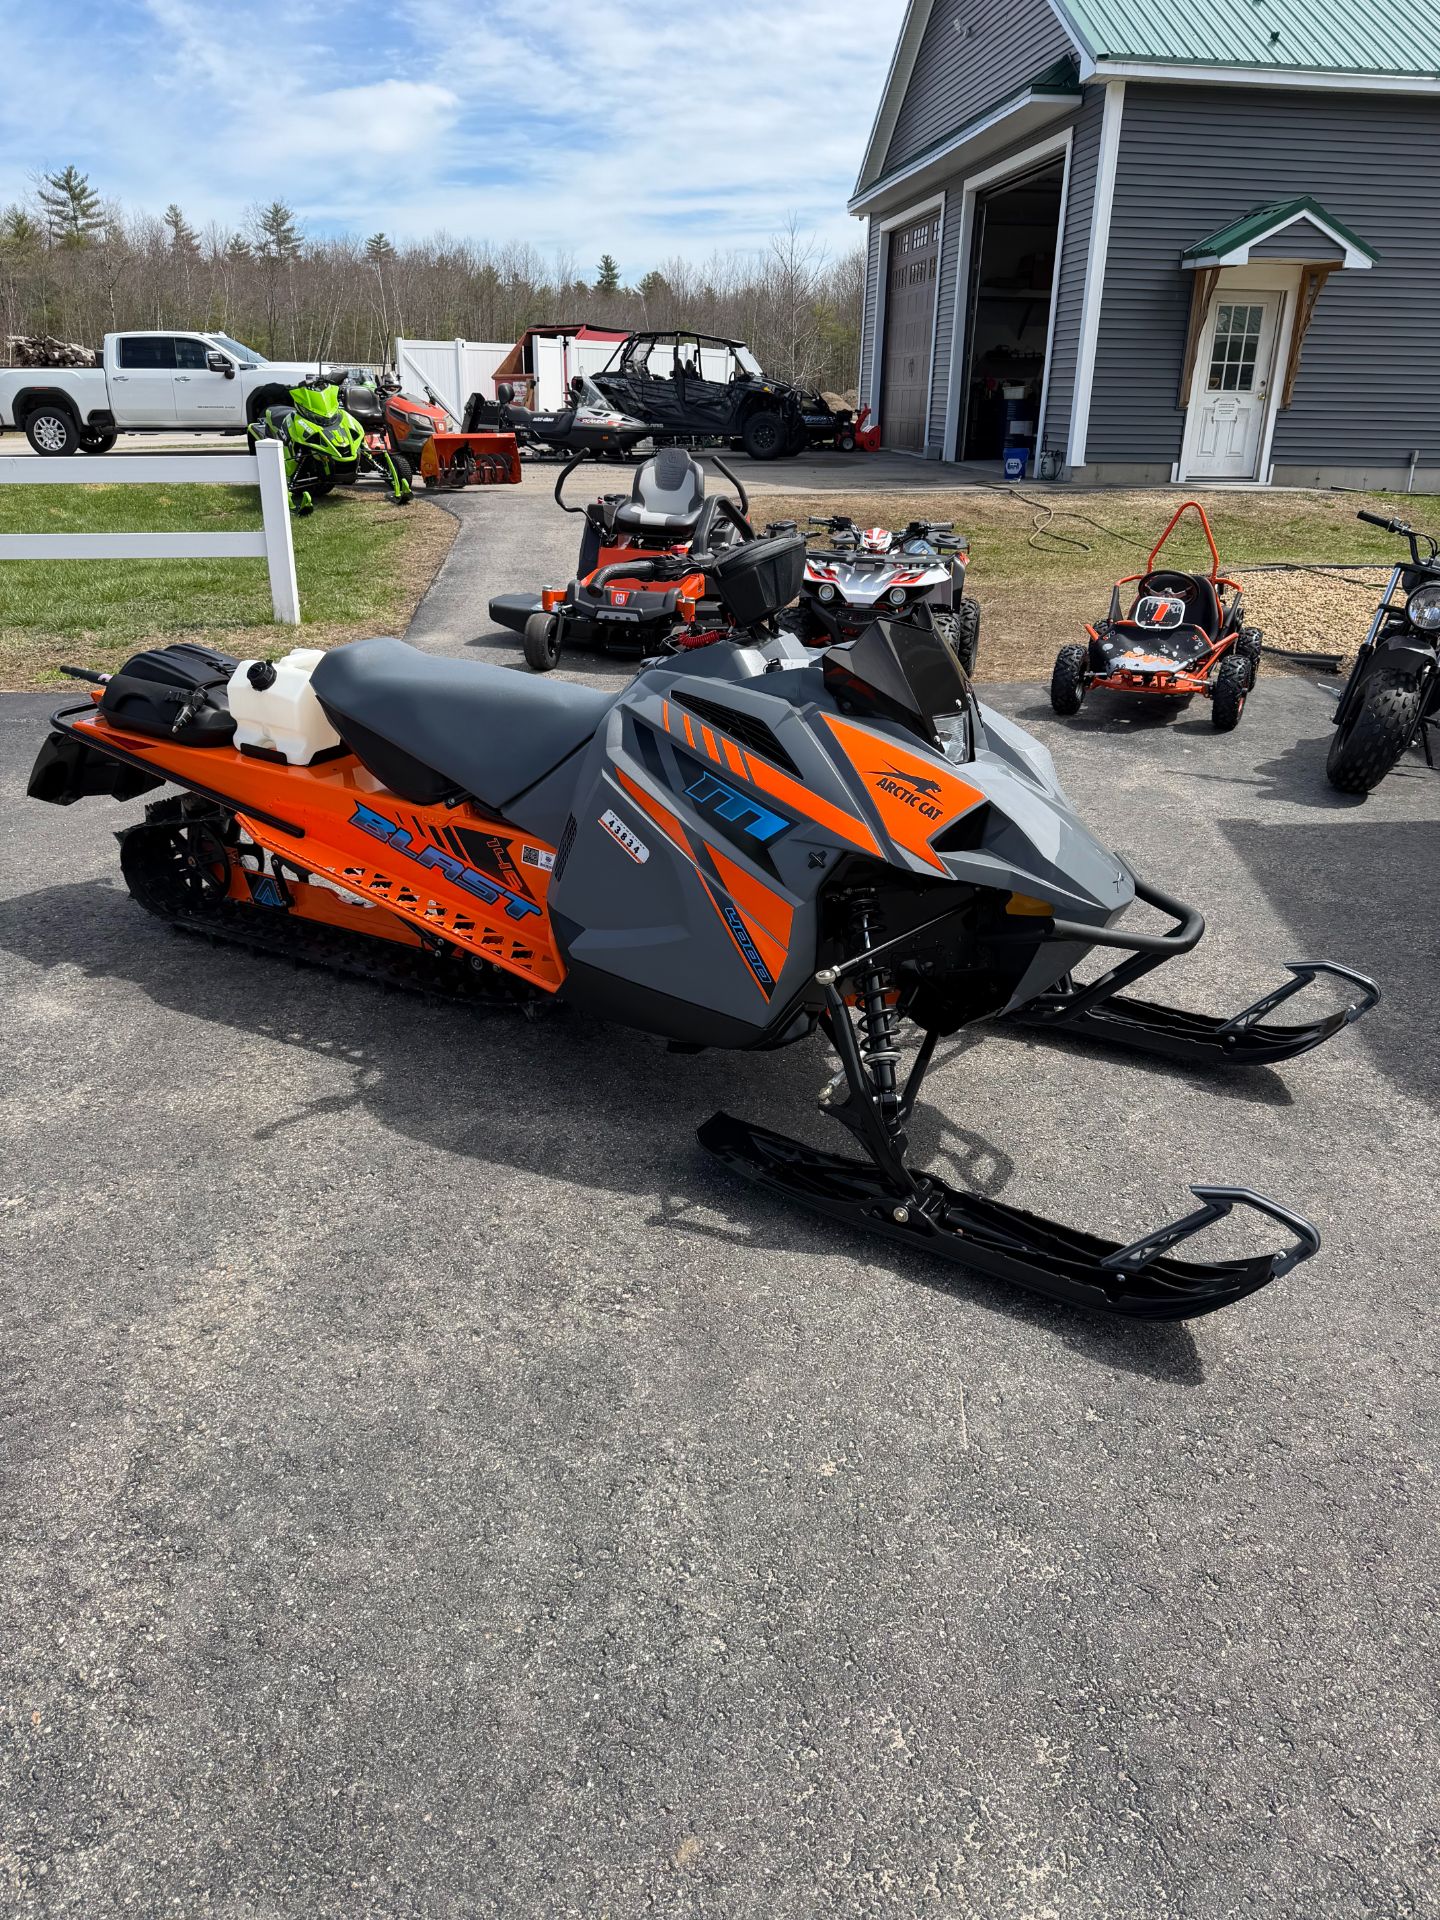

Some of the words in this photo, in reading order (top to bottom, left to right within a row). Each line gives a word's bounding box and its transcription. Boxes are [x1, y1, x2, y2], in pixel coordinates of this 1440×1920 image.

[876, 777, 921, 808] ARCTIC
[918, 801, 944, 821] CAT
[608, 820, 640, 854] 43834
[347, 799, 543, 922] BLAST
